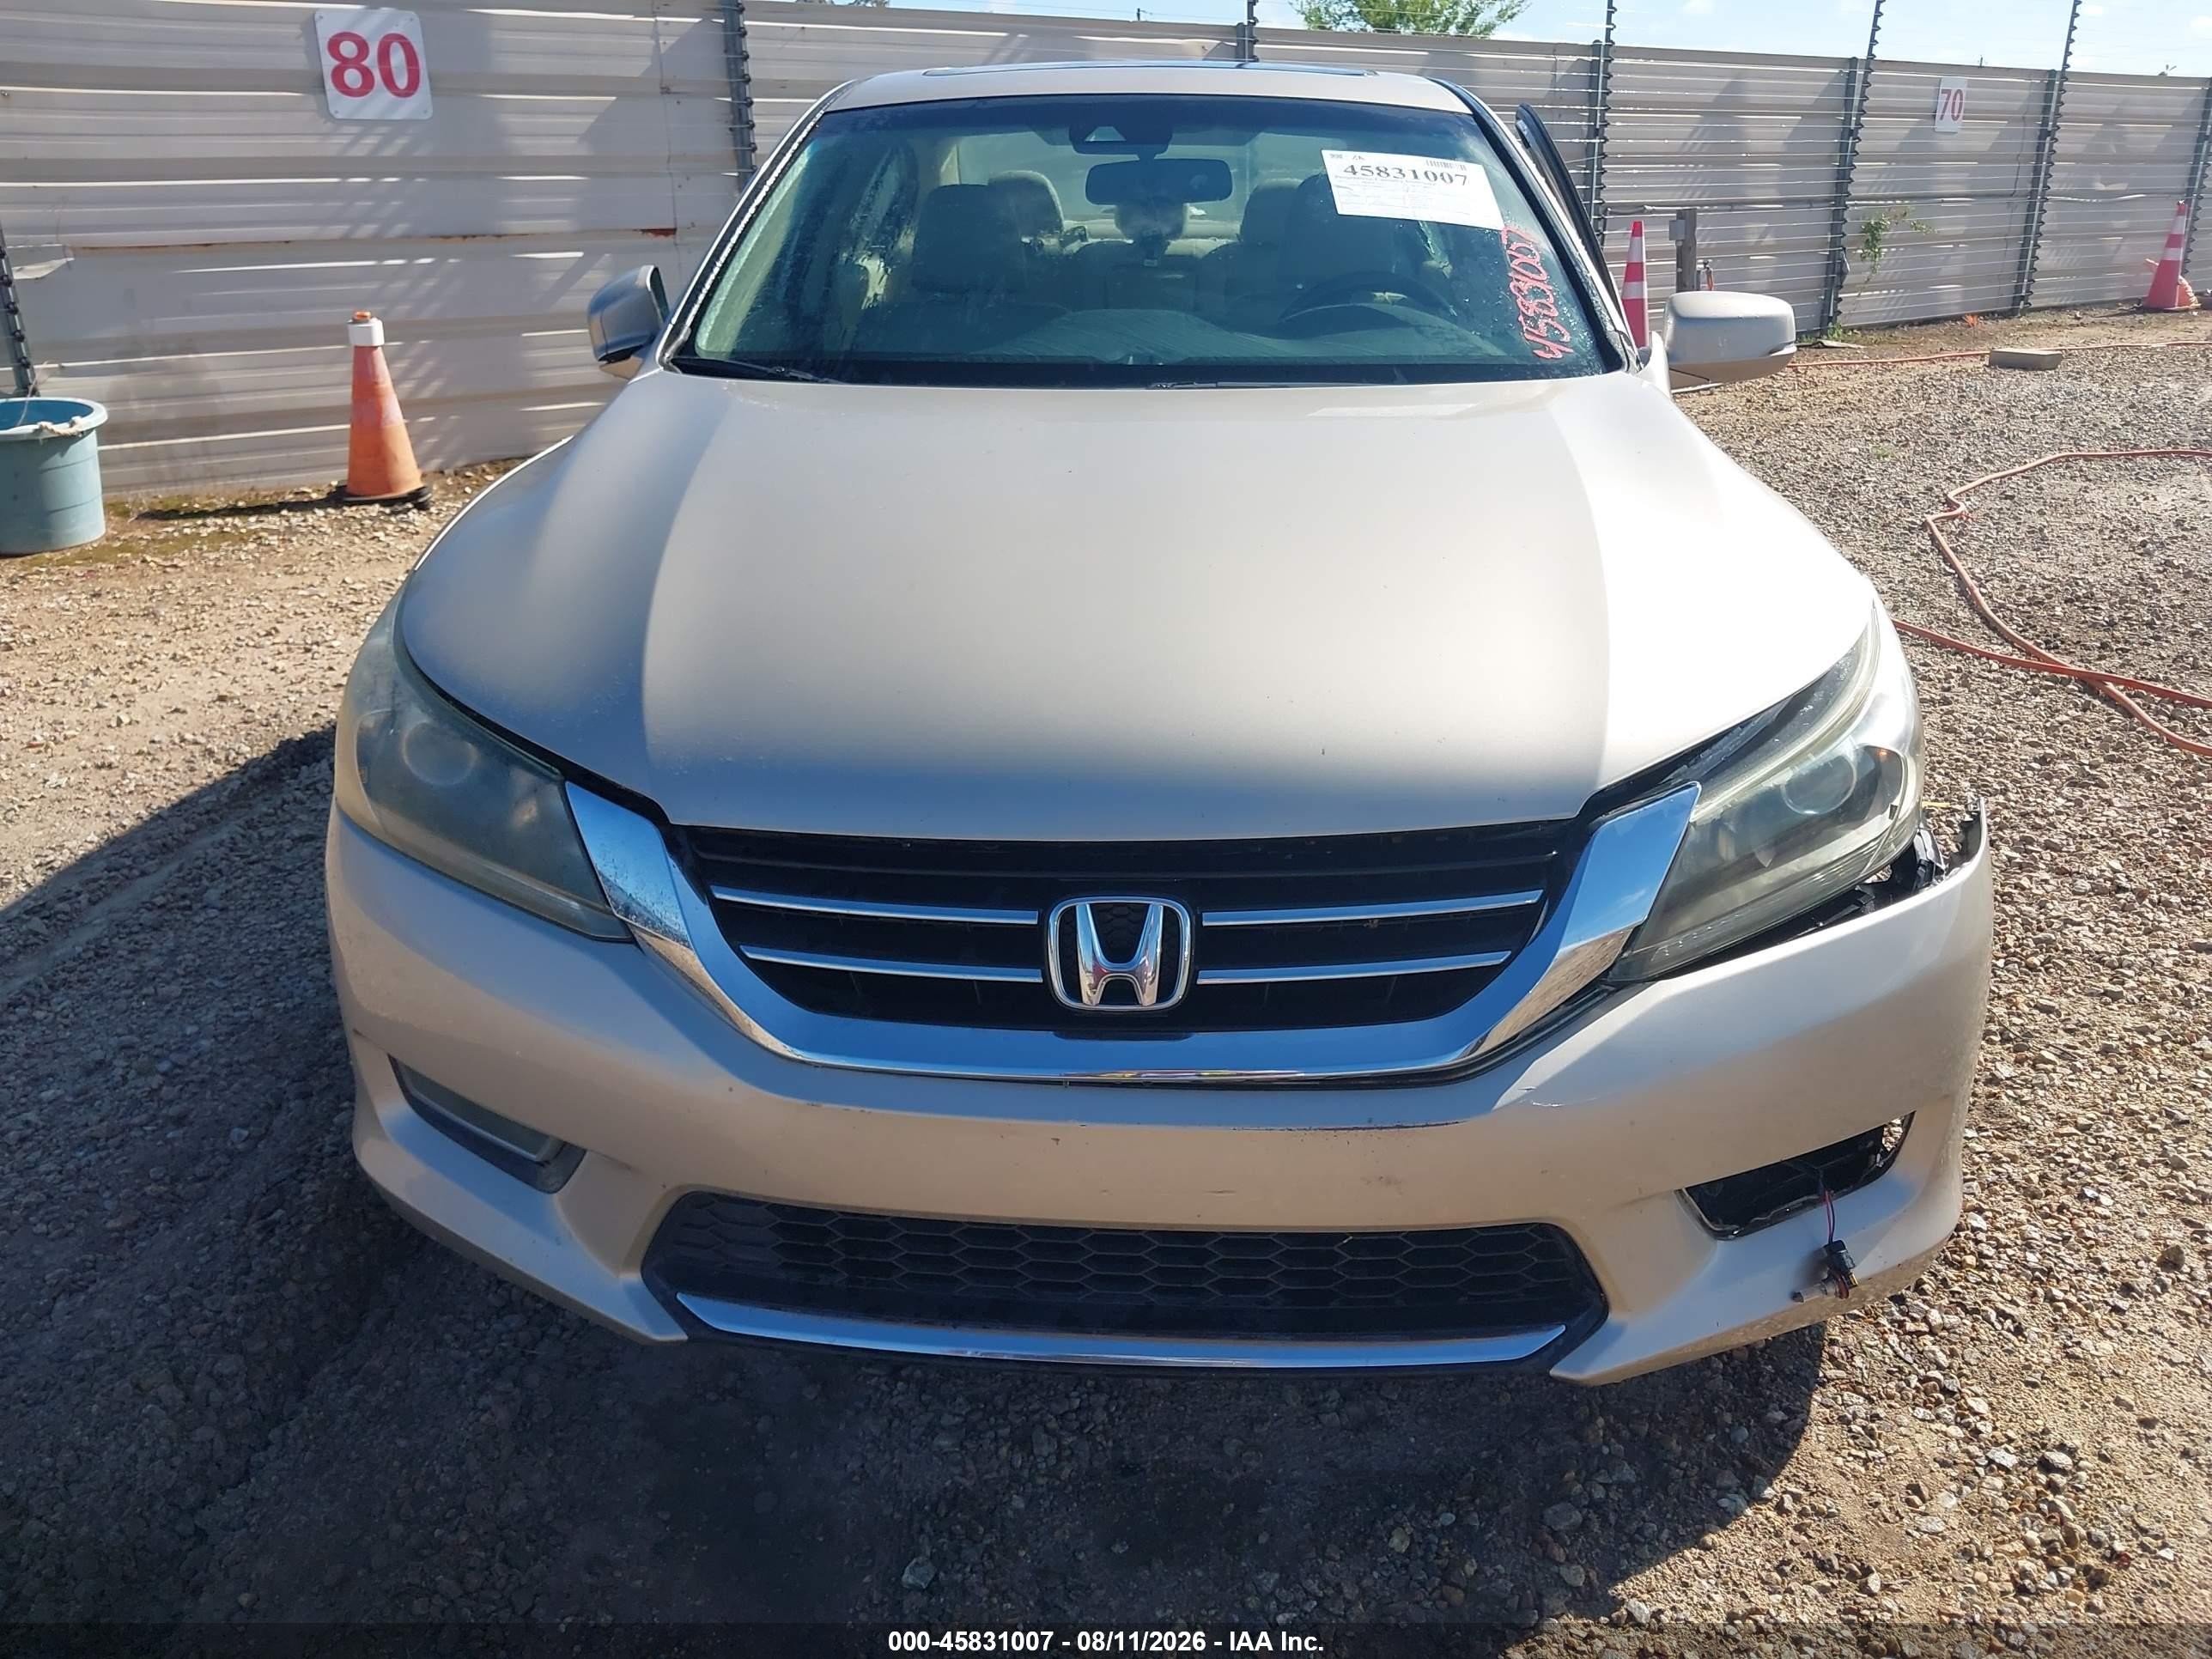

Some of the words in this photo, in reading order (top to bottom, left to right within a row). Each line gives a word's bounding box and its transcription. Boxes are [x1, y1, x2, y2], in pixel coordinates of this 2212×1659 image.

[327, 31, 421, 98] 80
[1940, 88, 1964, 122] 70
[1343, 164, 1468, 186] 45831007
[1500, 225, 1574, 360] 45831007
